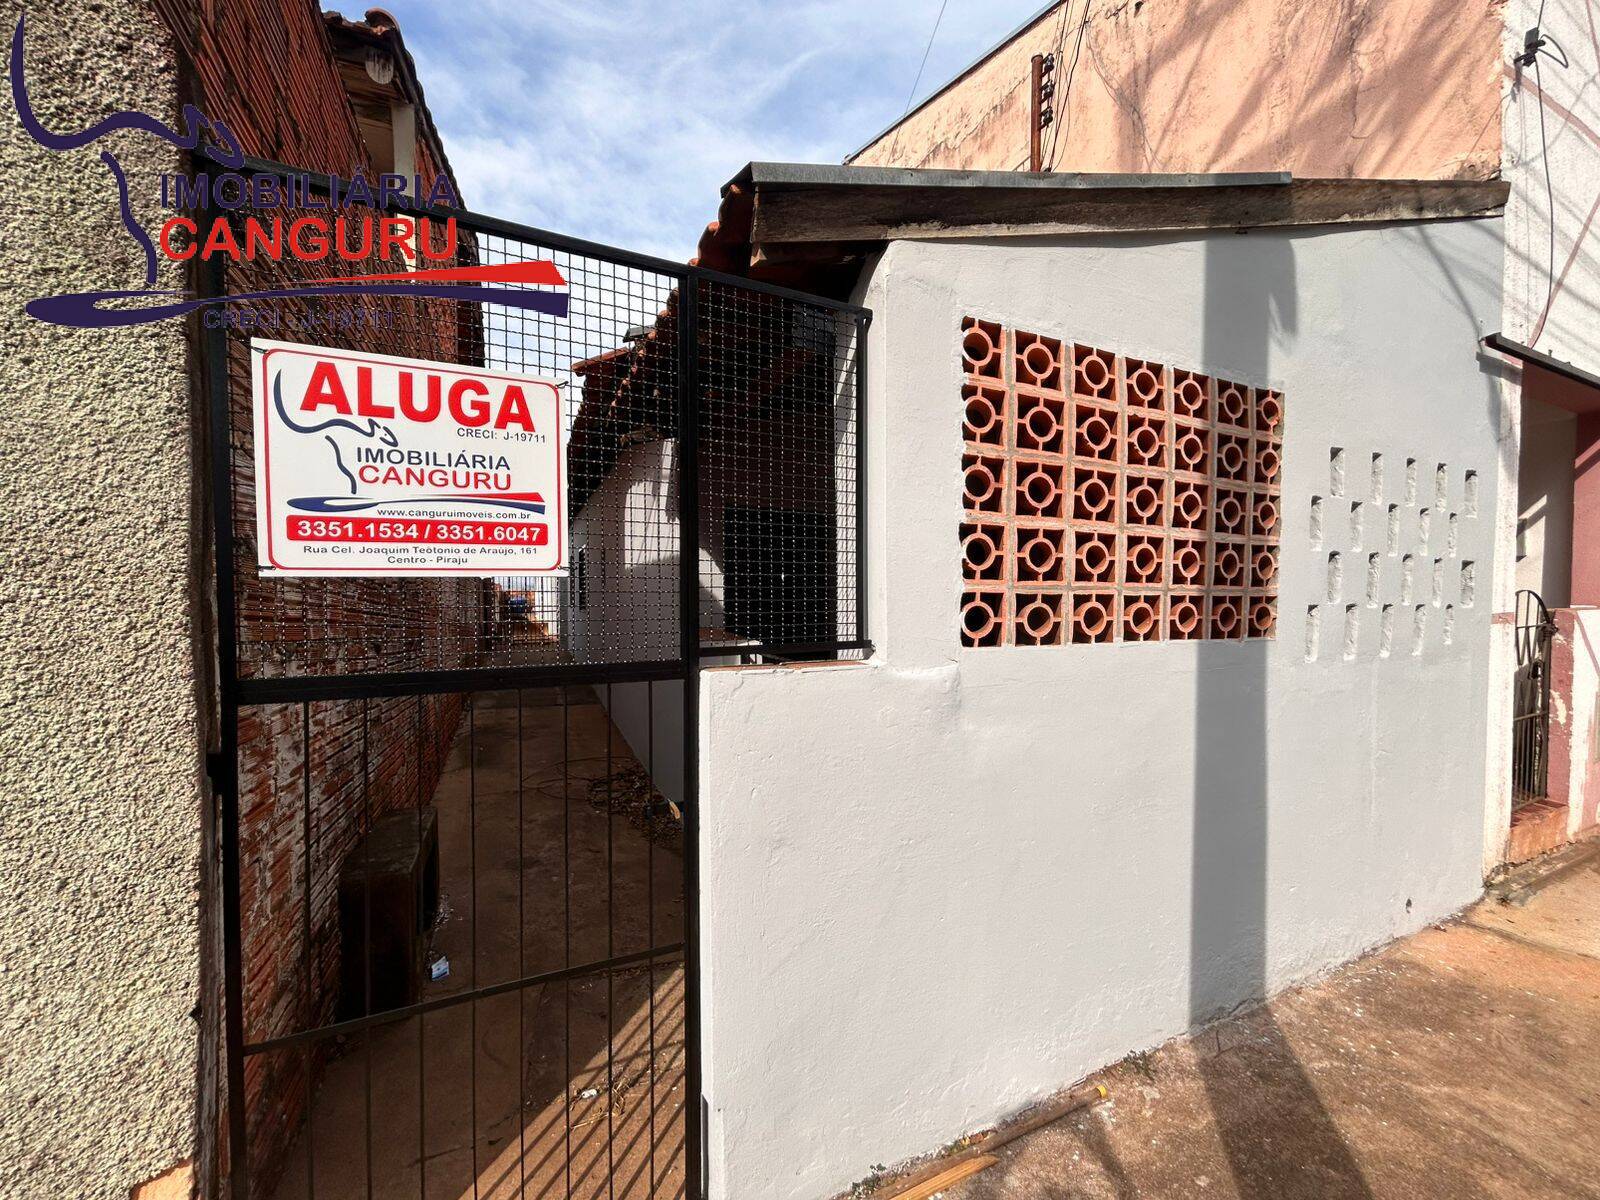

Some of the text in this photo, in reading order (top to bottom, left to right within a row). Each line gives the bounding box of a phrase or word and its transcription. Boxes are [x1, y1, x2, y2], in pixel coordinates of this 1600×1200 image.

[299, 361, 536, 432] ALUGA
[457, 427, 546, 443] CRECI: J-19711
[357, 446, 511, 471] IMOBILIÁRIA
[358, 464, 512, 491] CANGURU
[377, 508, 531, 520] www.canguruimoveis.com.br
[297, 520, 419, 538] 3351.1534
[436, 524, 541, 542] 3351.6047
[303, 545, 328, 554] Rua
[331, 545, 355, 554] Cel.
[358, 546, 409, 555] Joaquim
[463, 547, 477, 555] de
[521, 547, 538, 555] 161
[387, 556, 427, 564] Centro
[436, 556, 468, 565] Piraju
